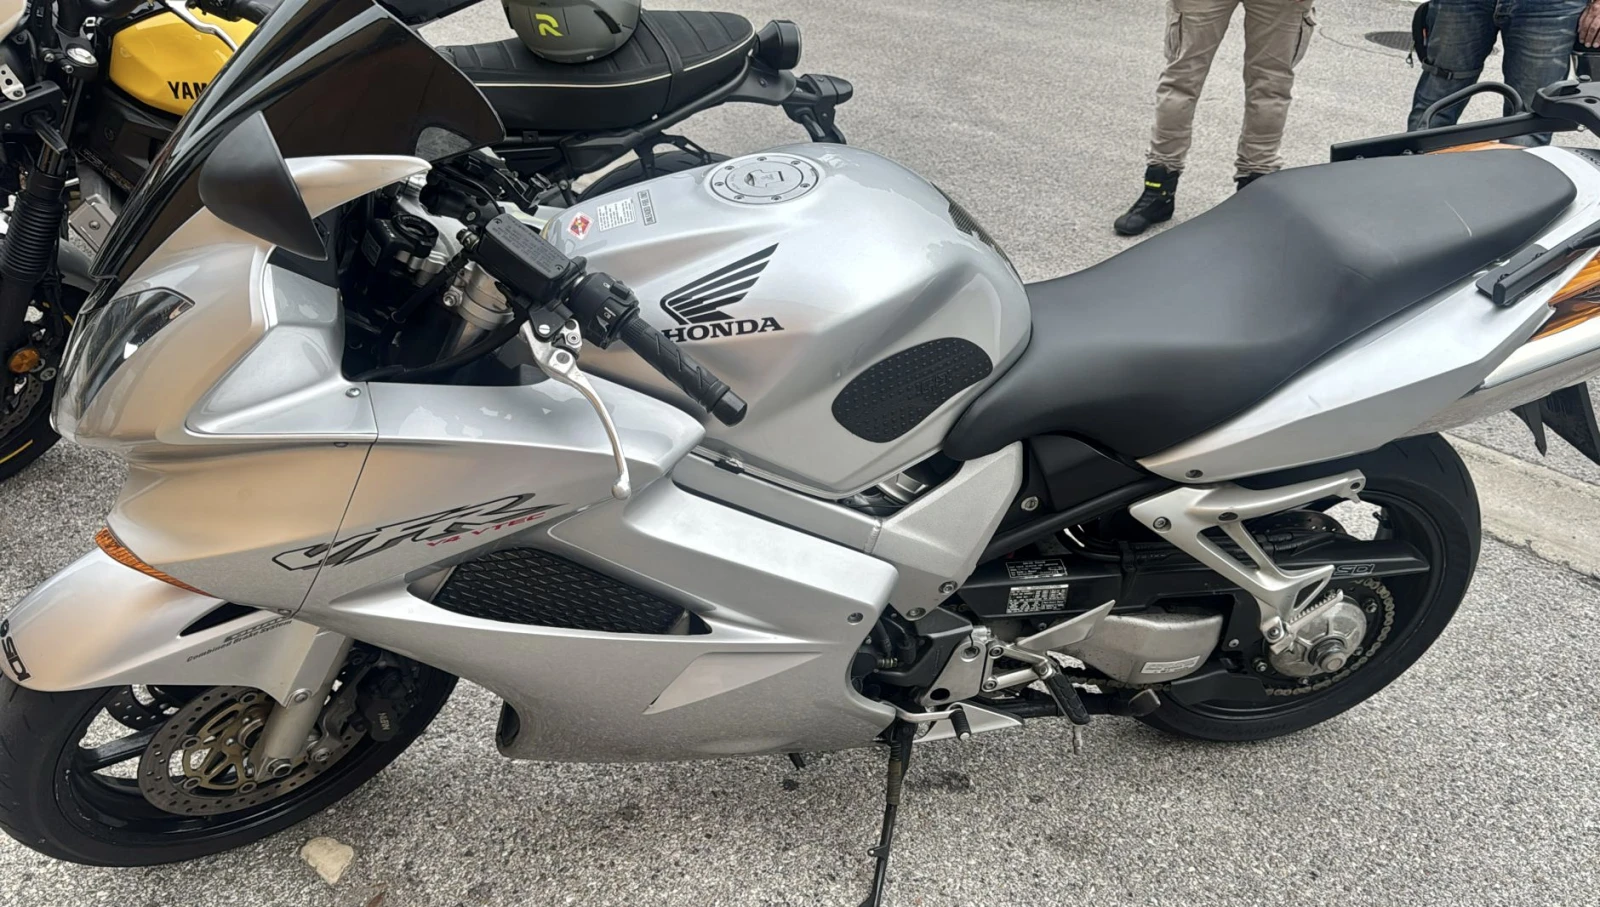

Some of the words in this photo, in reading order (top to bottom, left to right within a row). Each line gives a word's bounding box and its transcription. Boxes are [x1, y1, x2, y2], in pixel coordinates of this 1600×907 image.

[661, 317, 785, 343] HONDA
[427, 534, 461, 547] V4
[472, 511, 546, 536] VTEC
[187, 641, 232, 662] Combined
[233, 632, 258, 645] Brake
[260, 620, 292, 634] System
